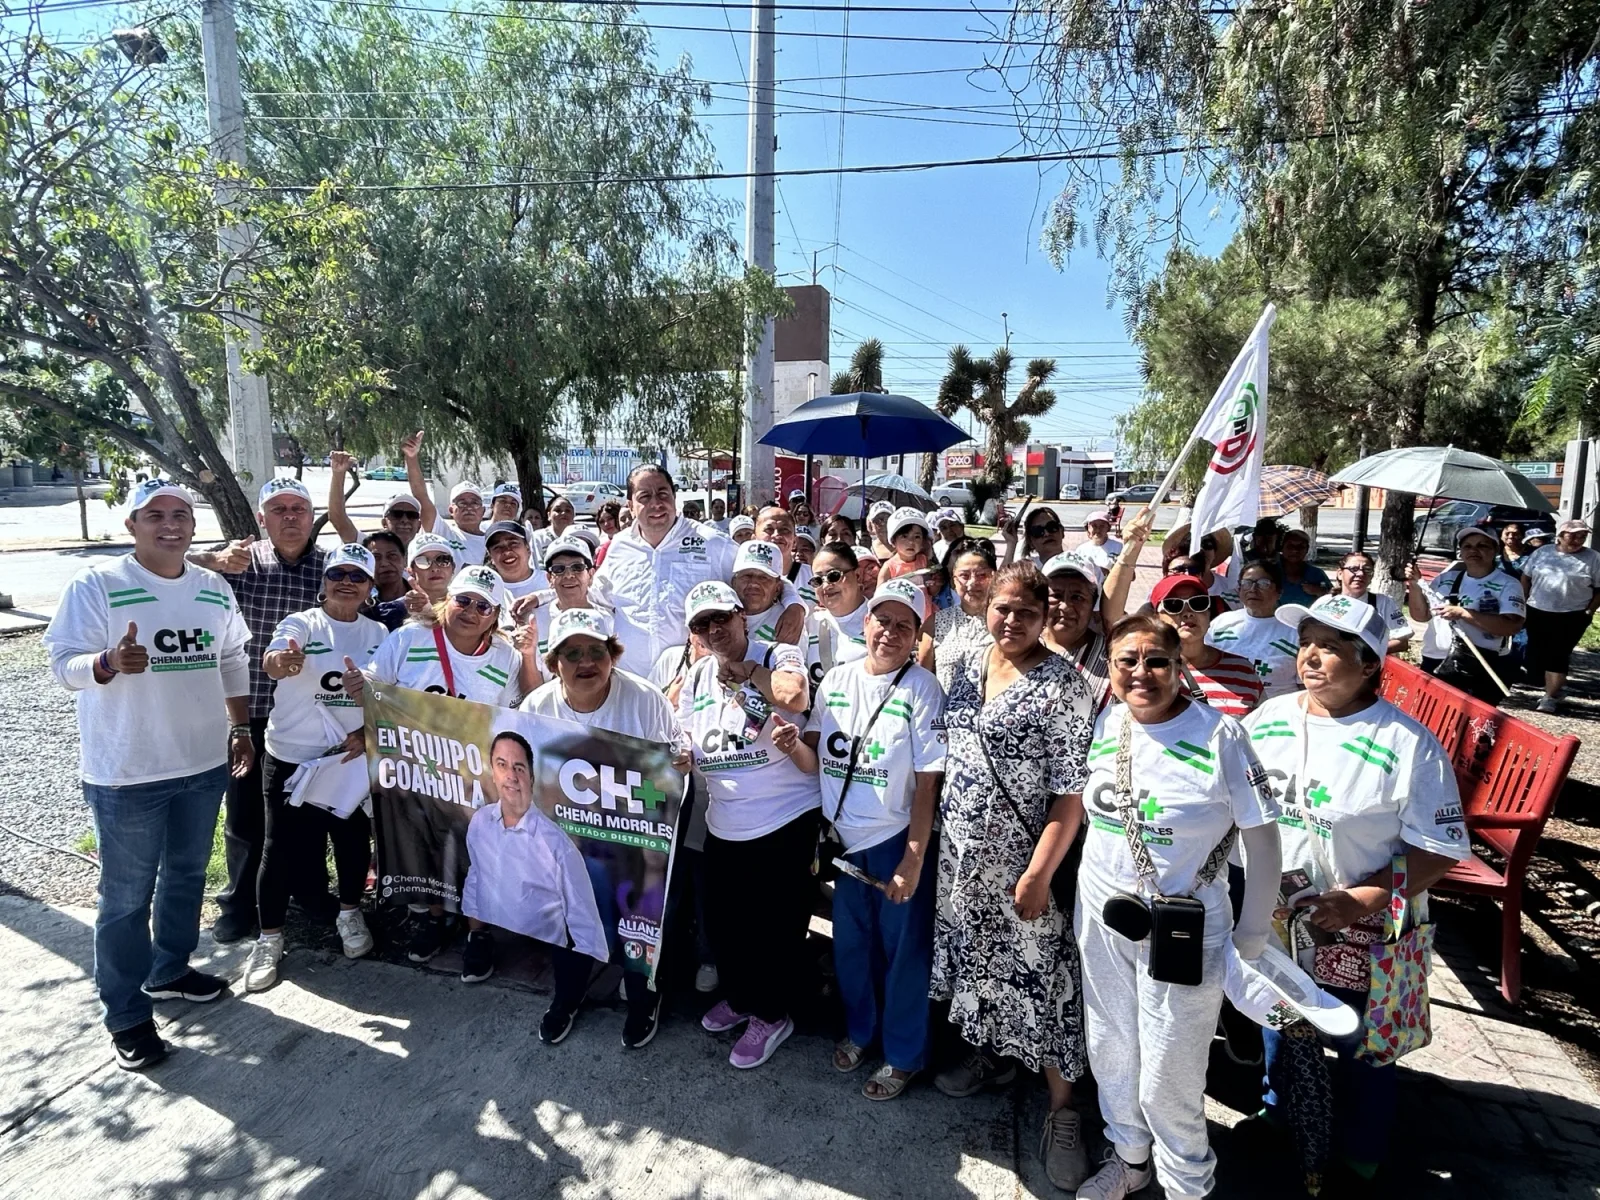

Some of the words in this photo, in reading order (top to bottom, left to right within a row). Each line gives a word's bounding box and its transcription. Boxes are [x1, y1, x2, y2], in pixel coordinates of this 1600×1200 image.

[948, 456, 971, 465] OXXO
[1516, 463, 1548, 474] SA
[682, 537, 705, 546] CH+
[154, 628, 215, 653] CH+
[151, 655, 182, 665] CHEMA
[184, 653, 217, 663] MORALE
[378, 728, 397, 748] EN
[398, 725, 483, 776] EQUIPO
[697, 756, 723, 766] CHEMA
[724, 749, 768, 762] MORALES
[379, 757, 486, 810] COAHUILA
[559, 758, 666, 814] CH+
[1435, 805, 1462, 819] ALIAN
[555, 804, 602, 826] CHEMA
[606, 815, 673, 840] MORALES
[560, 822, 606, 838] DIPUTADO
[611, 833, 656, 848] DISTRITO
[661, 842, 669, 851] 12
[393, 875, 427, 883] Chema
[428, 877, 457, 892] Morales
[618, 917, 660, 938] ALIANZ
[1340, 953, 1362, 964] Cabo
